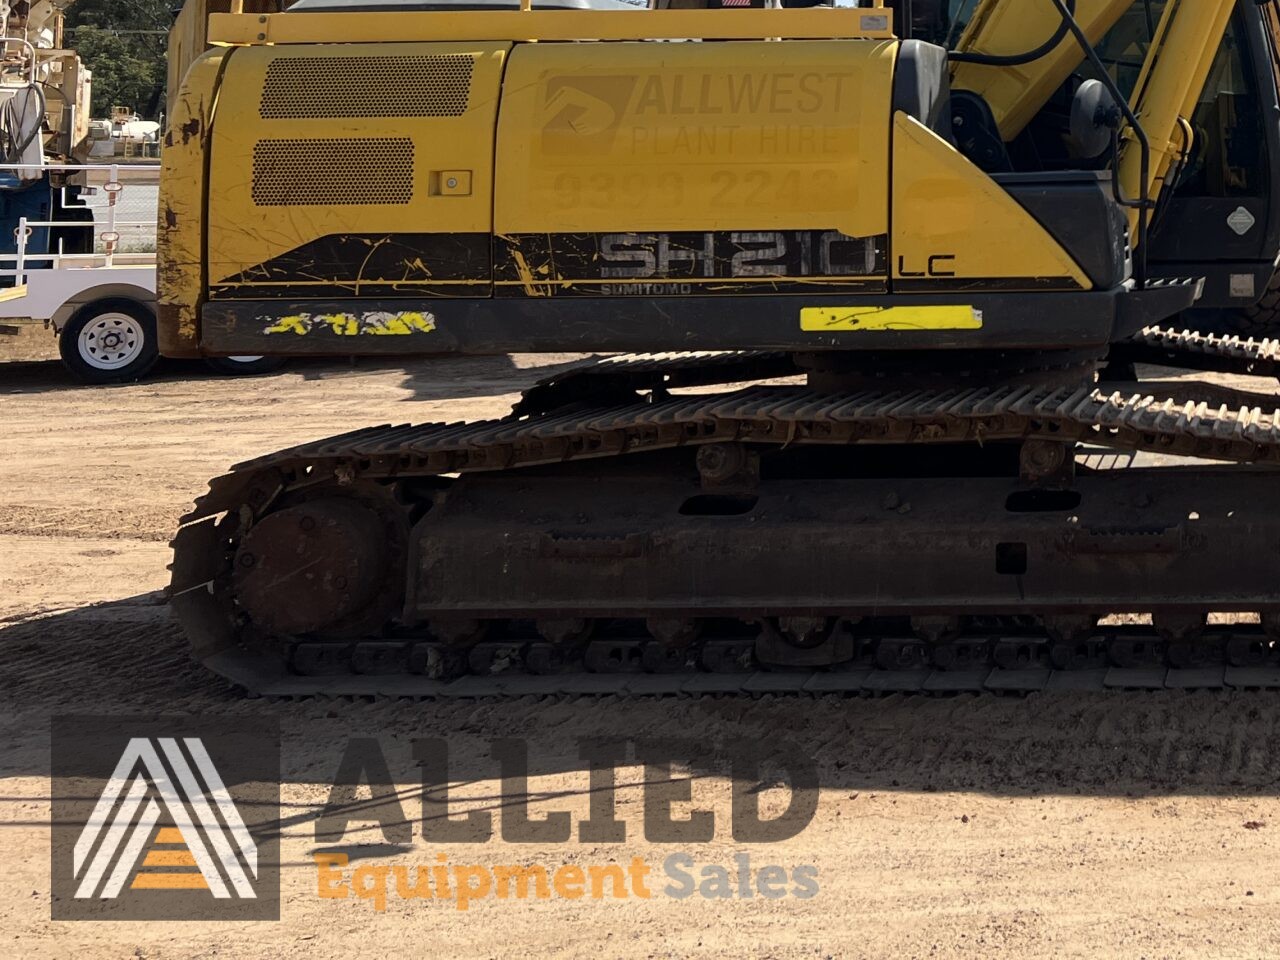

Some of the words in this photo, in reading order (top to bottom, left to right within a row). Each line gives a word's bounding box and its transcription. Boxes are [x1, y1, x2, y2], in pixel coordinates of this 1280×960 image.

[634, 72, 854, 115] ALLWEST
[630, 124, 742, 156] PLANT
[758, 123, 841, 155] HIRE
[600, 231, 877, 278] SH210
[898, 254, 955, 277] LC
[600, 283, 692, 295] SUMITOMO
